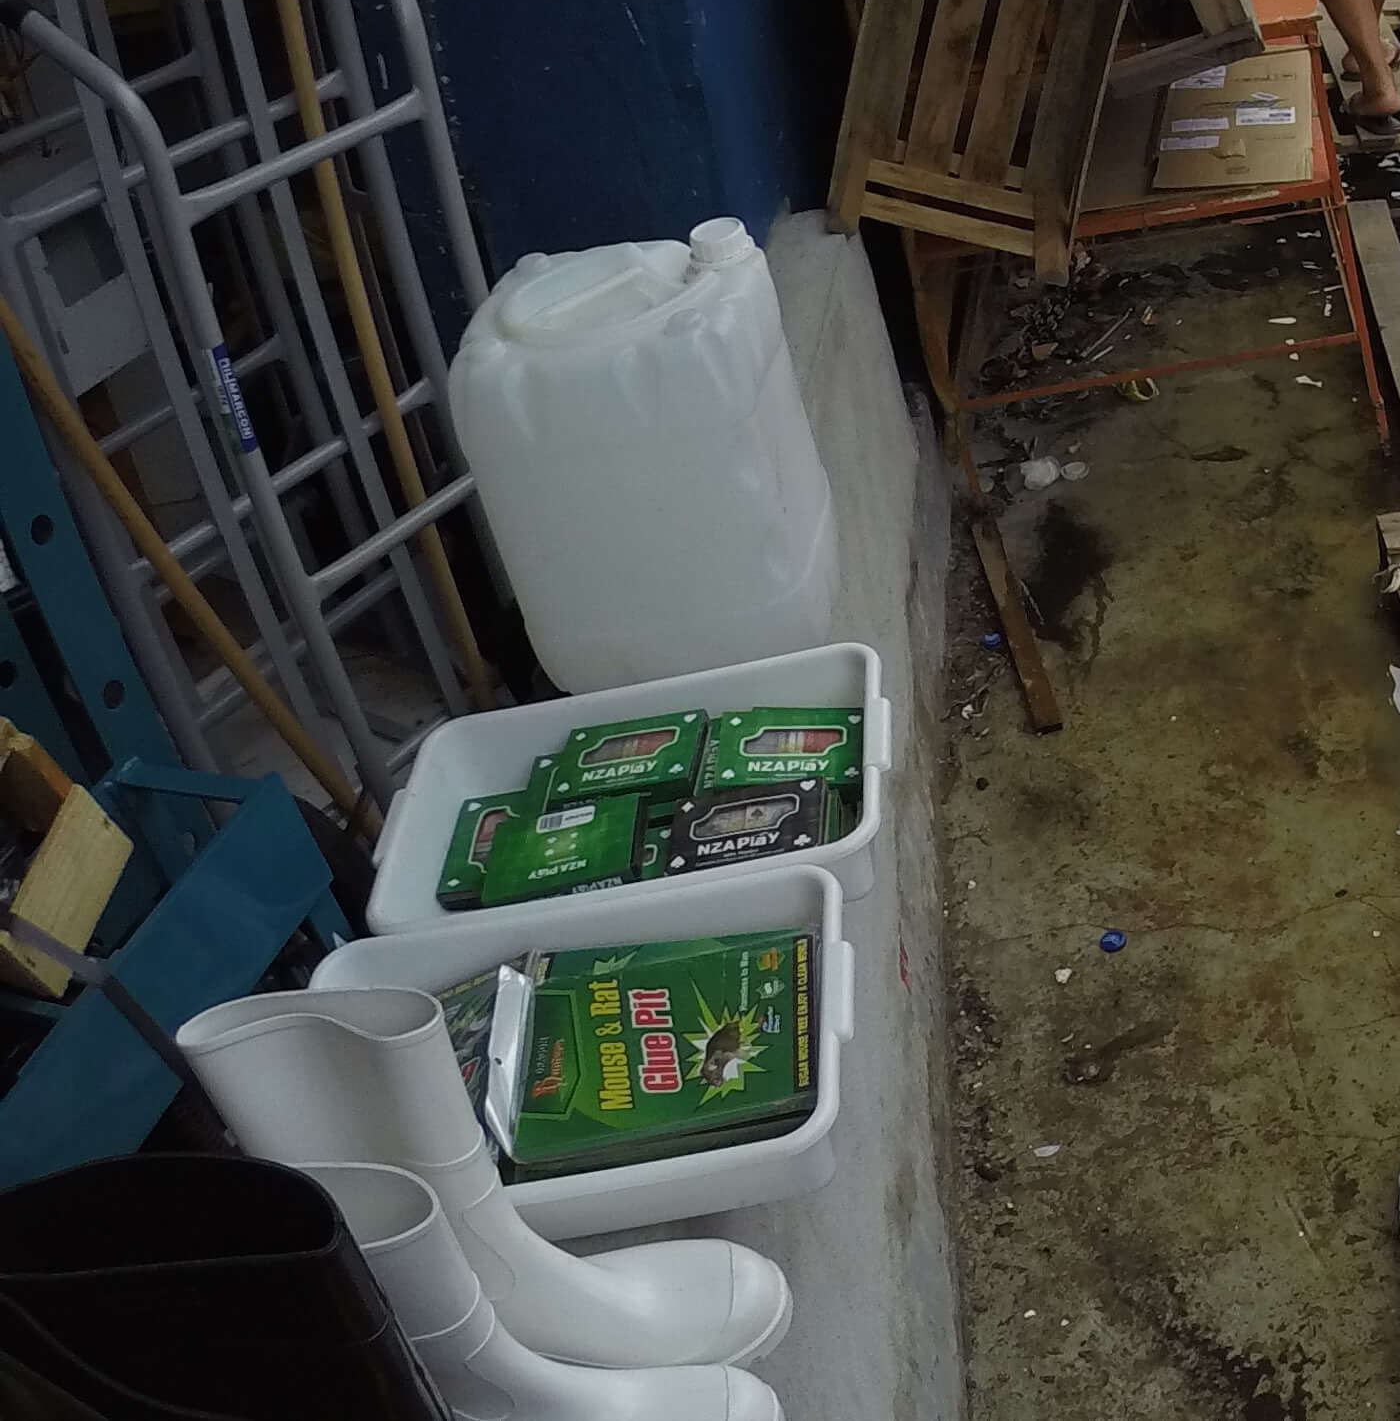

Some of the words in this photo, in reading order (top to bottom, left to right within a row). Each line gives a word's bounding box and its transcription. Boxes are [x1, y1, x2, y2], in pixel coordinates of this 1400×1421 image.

[588, 978, 621, 1017] Rat
[627, 988, 673, 1029] Pit
[594, 1020, 623, 1036] &
[599, 1041, 634, 1110] Mouse
[639, 1032, 682, 1094] Glue
